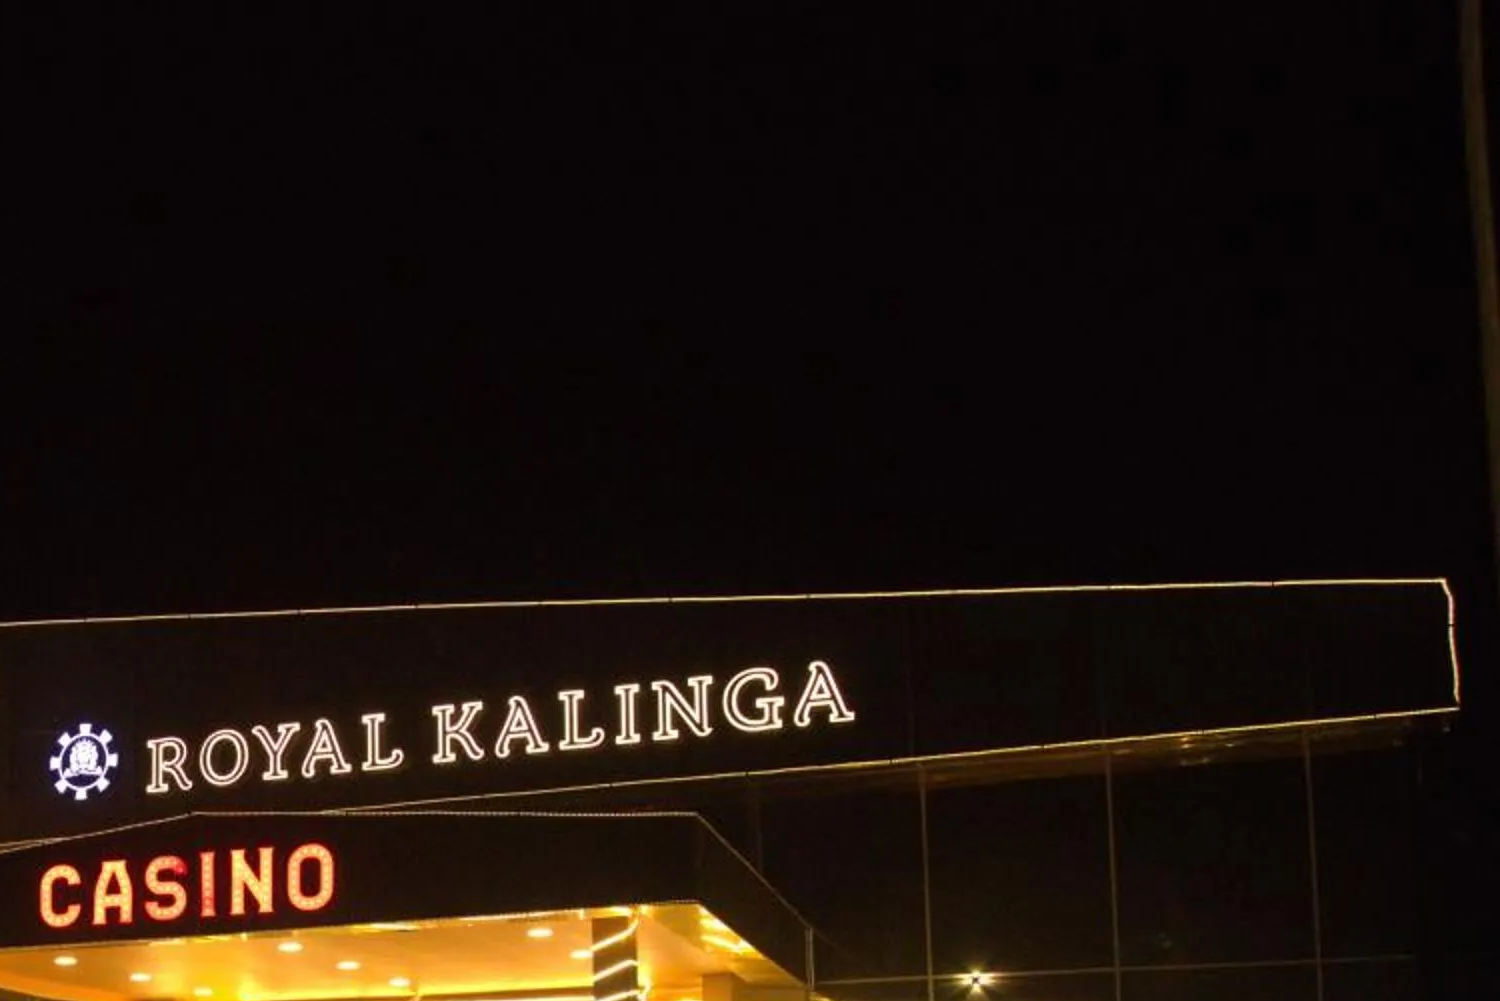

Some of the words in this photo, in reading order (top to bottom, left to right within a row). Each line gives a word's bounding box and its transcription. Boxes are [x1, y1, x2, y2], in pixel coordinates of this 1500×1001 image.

[145, 711, 404, 793] ROYAL
[431, 660, 856, 763] KALINGA
[38, 843, 336, 928] CASINO
